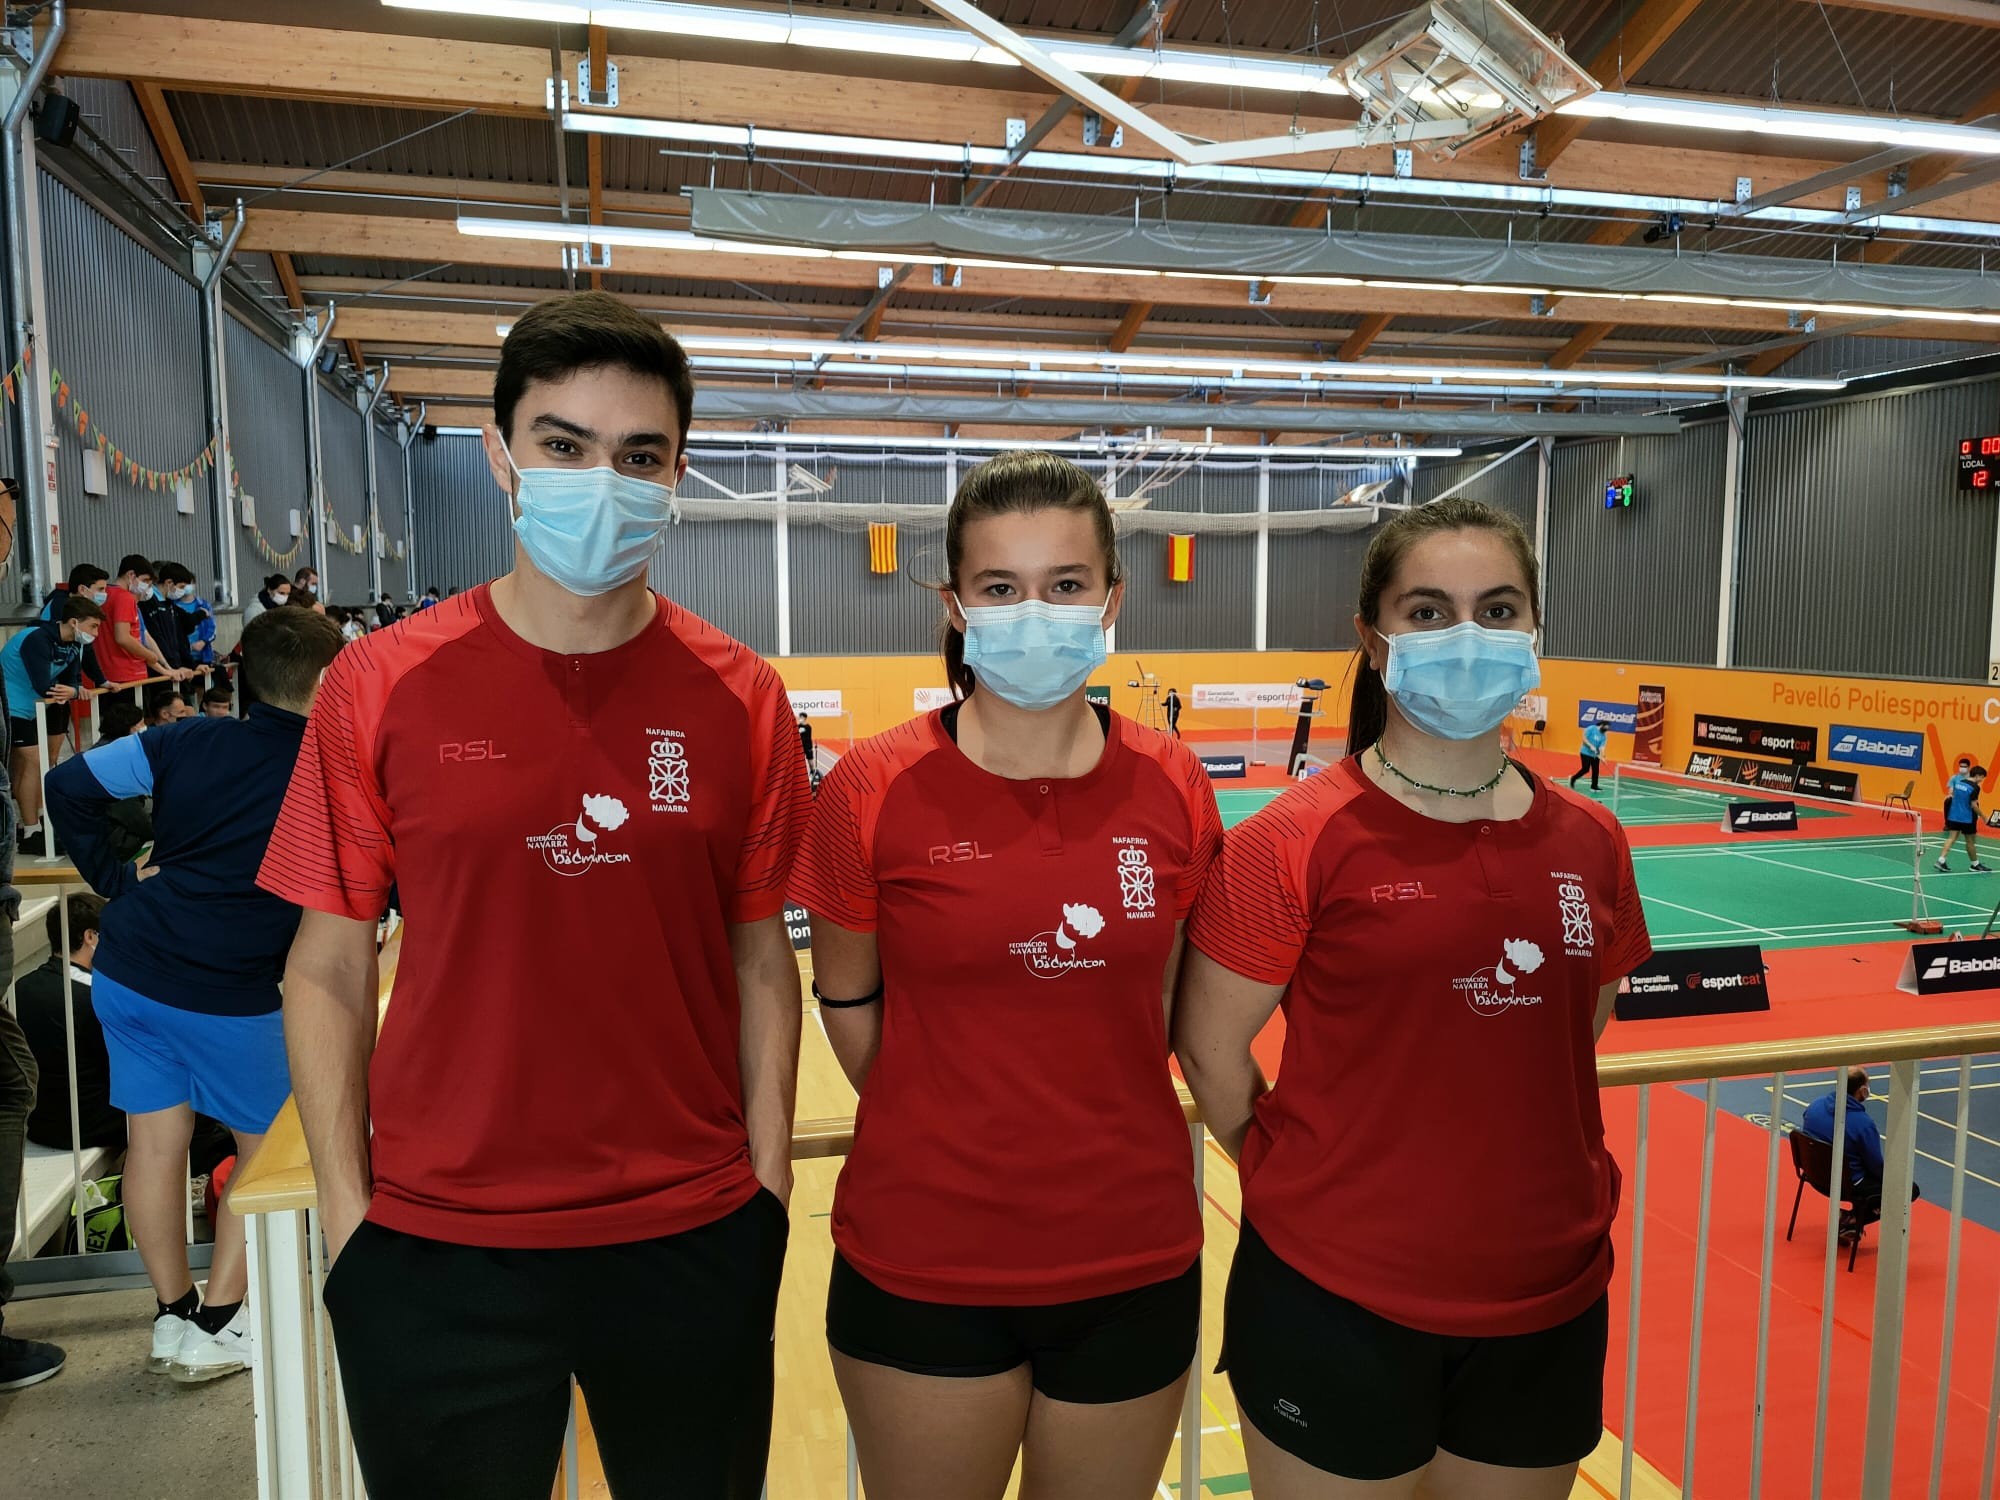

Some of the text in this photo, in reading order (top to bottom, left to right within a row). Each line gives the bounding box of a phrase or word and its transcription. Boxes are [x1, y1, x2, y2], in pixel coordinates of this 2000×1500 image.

[1962, 460, 1985, 469] LOCAL
[1973, 470, 1988, 487] 12
[792, 700, 839, 710] esportcat
[1772, 681, 1841, 710] Pavelló
[1848, 687, 1981, 723] Poliesportiu
[645, 727, 686, 739] NAFARROA
[1761, 736, 1811, 751] esportcat
[1856, 738, 1918, 758] Babolat
[440, 739, 507, 764] RSL
[651, 803, 689, 814] NAVARRA
[1751, 811, 1793, 822] Babolat
[527, 842, 569, 850] NAVARRA
[928, 840, 993, 866] RSL
[1370, 881, 1437, 903] RSL
[1126, 911, 1156, 920] NAVARRA
[1009, 947, 1048, 955] NAVARRA
[1564, 948, 1593, 958] NAVARRA
[1631, 974, 1670, 985] Generalitat
[1702, 972, 1761, 990] esportcat
[1452, 982, 1489, 990] NAVARRA
[1632, 983, 1679, 993] de Catalunya
